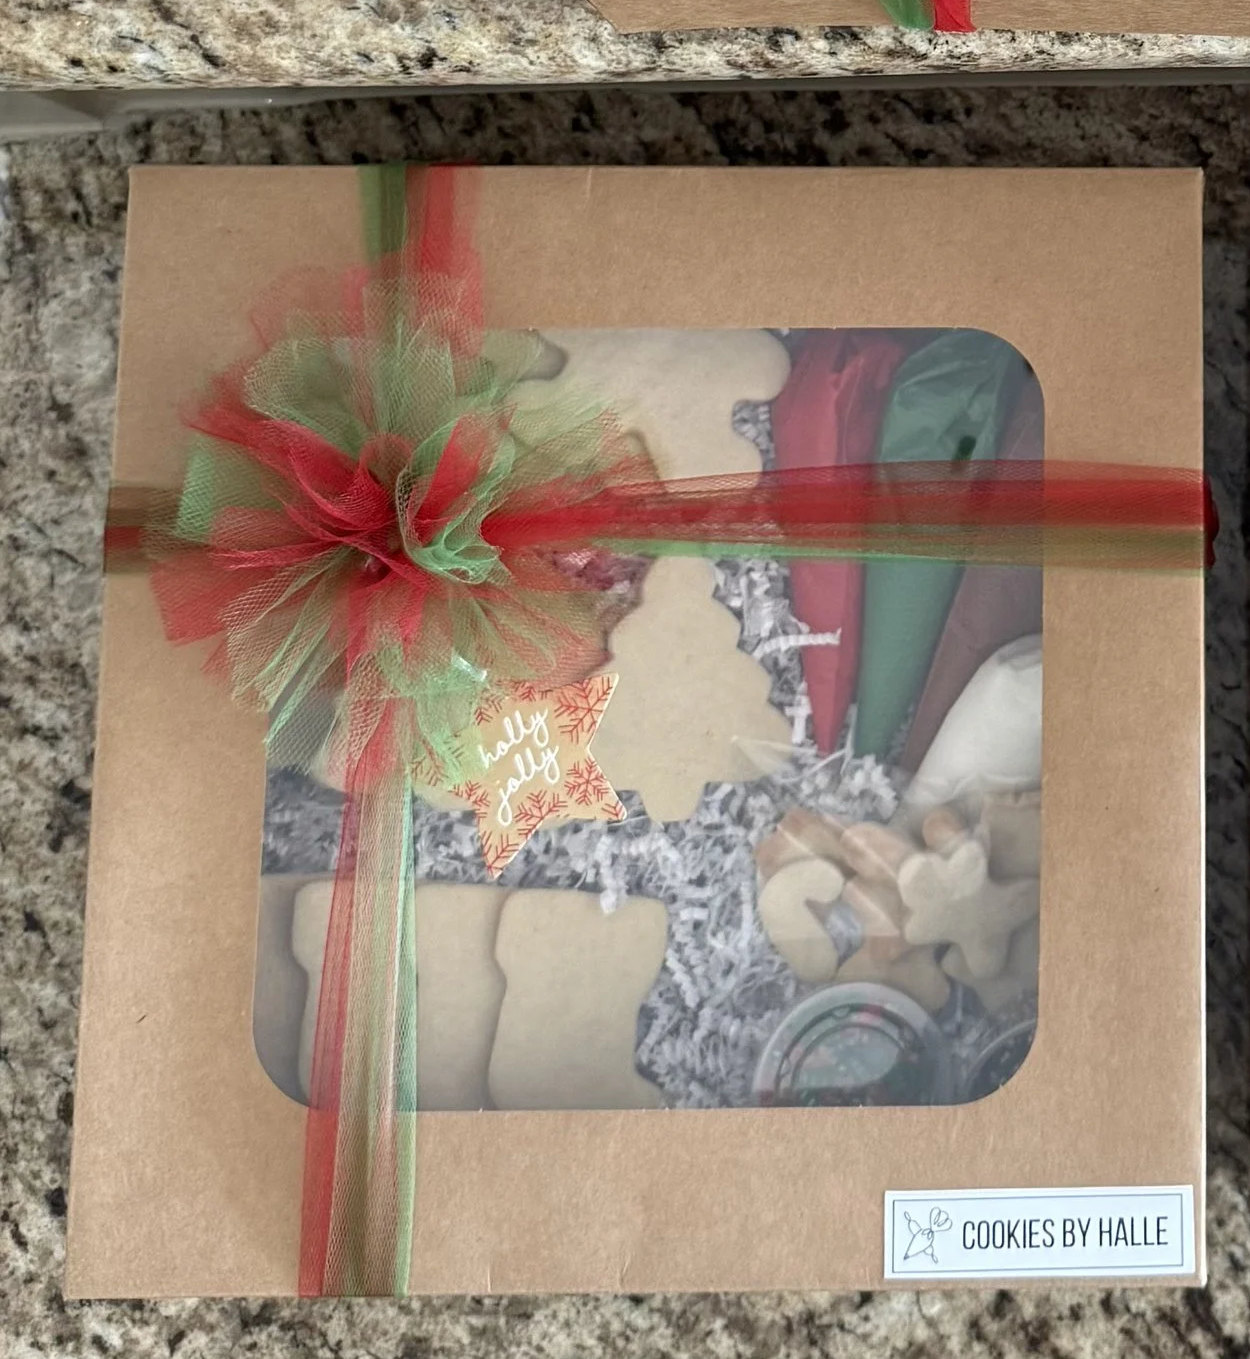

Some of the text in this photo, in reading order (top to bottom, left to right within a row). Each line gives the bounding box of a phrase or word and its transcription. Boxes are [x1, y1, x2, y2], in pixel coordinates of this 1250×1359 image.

[477, 707, 549, 770] holly
[497, 745, 560, 827] jolly
[962, 1216, 1169, 1250] COOKIES BY HALLE
